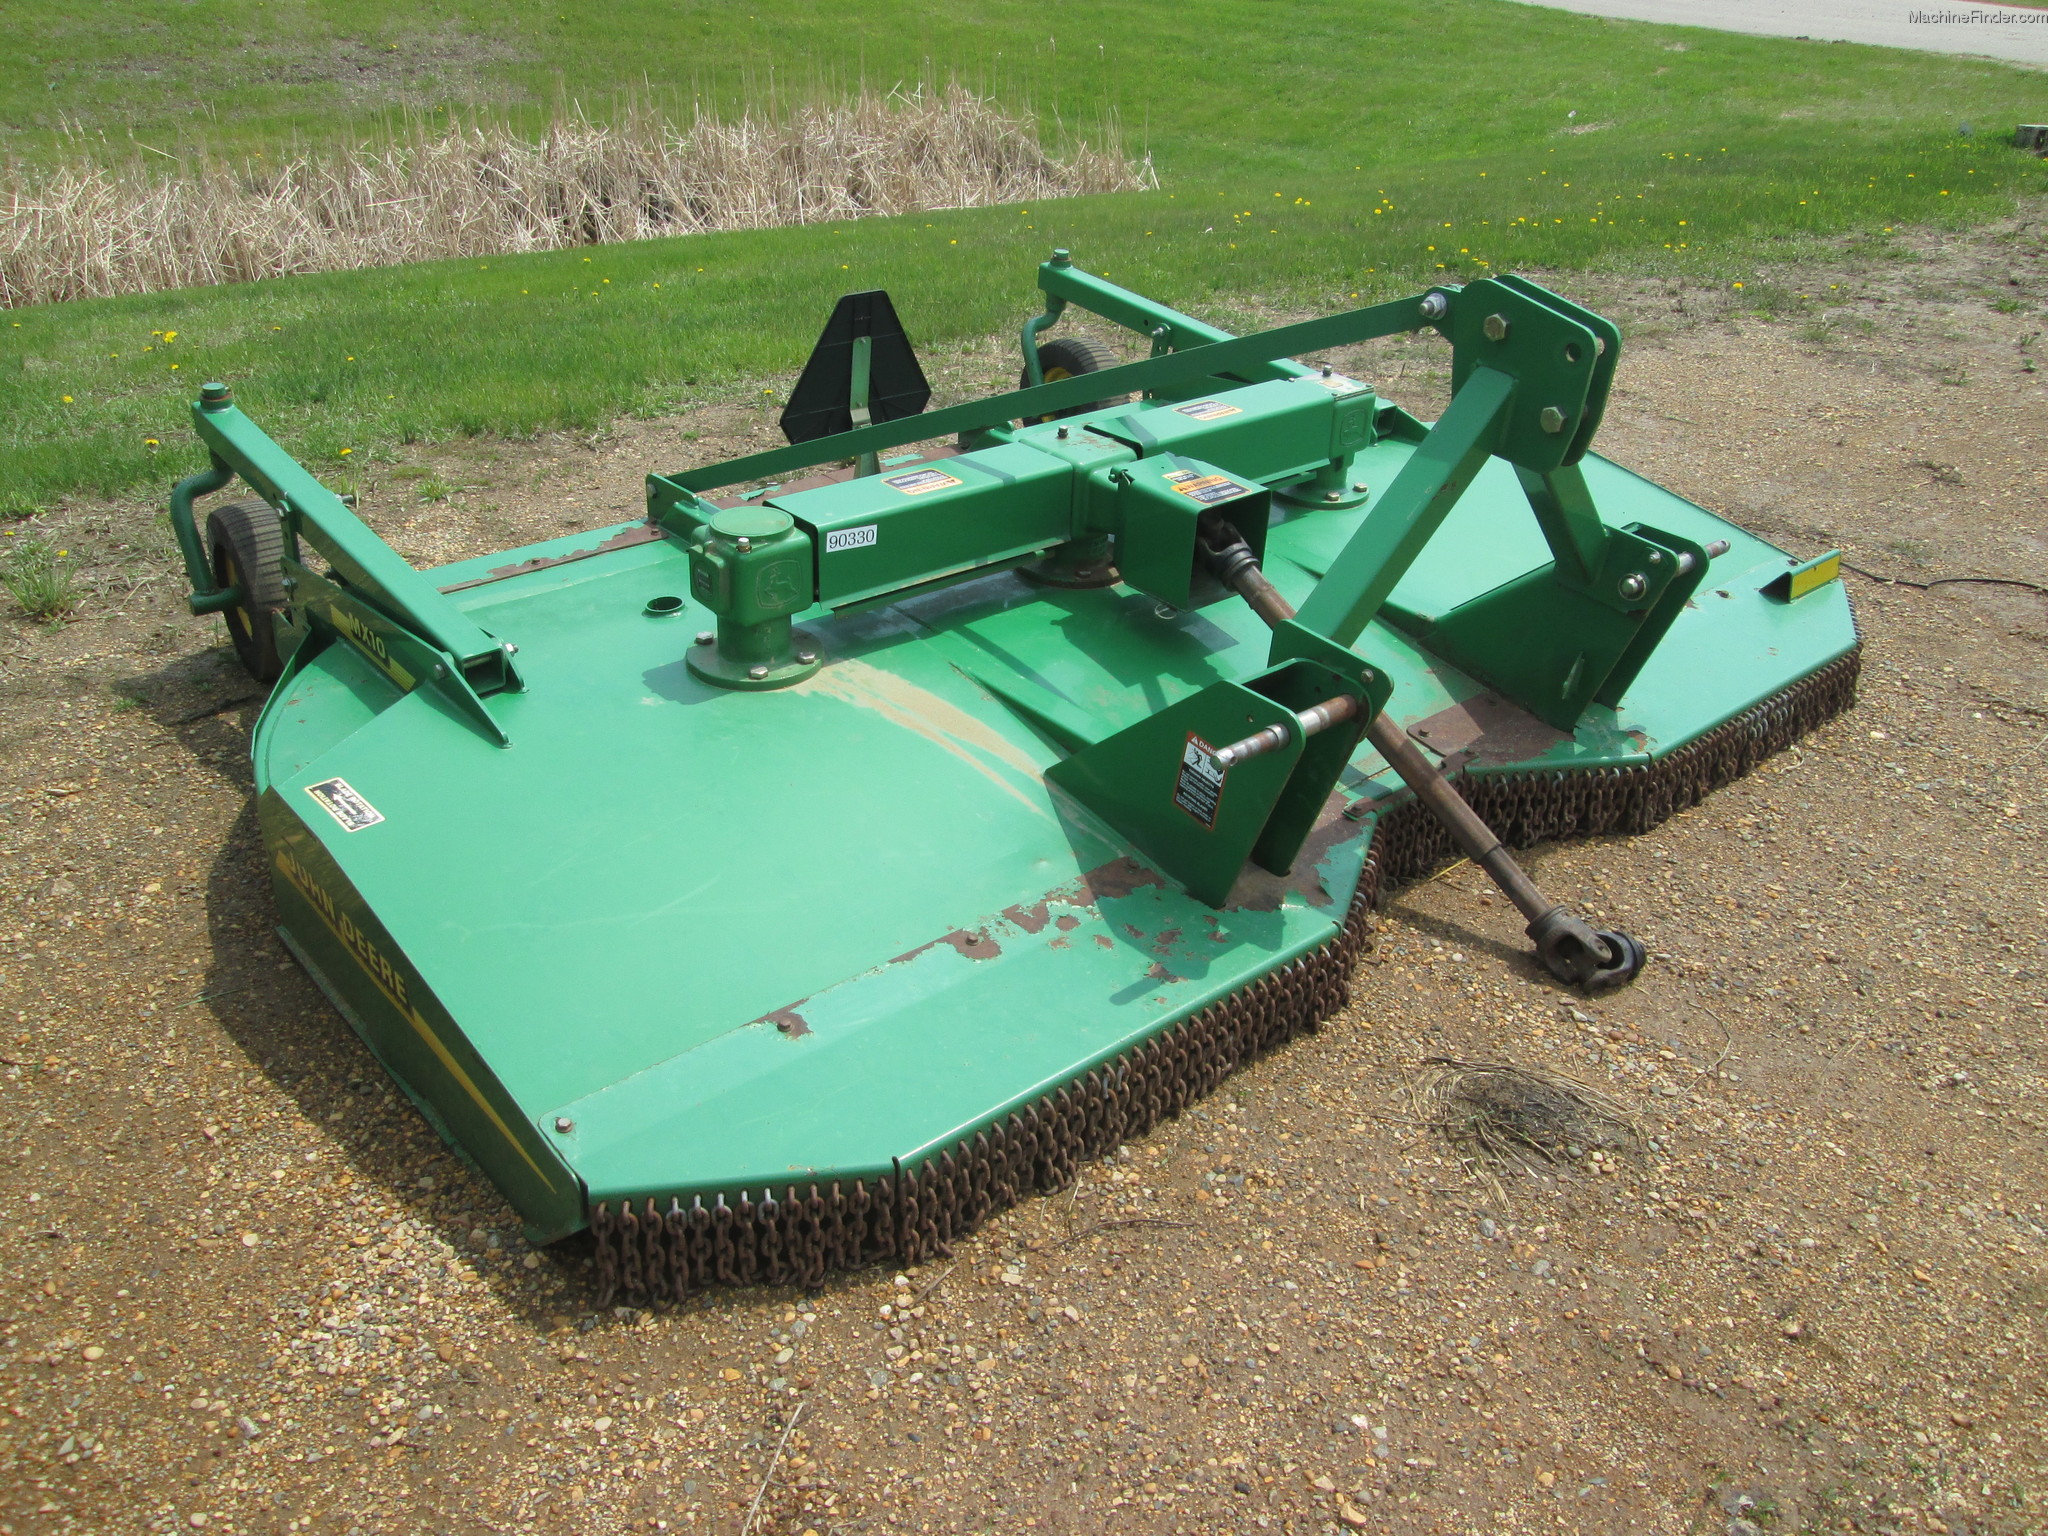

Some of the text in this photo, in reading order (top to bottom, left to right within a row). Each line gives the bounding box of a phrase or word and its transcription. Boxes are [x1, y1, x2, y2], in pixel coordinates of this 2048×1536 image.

[829, 529, 875, 549] 90330
[348, 612, 386, 659] MX10
[289, 850, 408, 1004] JOHN DEERE
